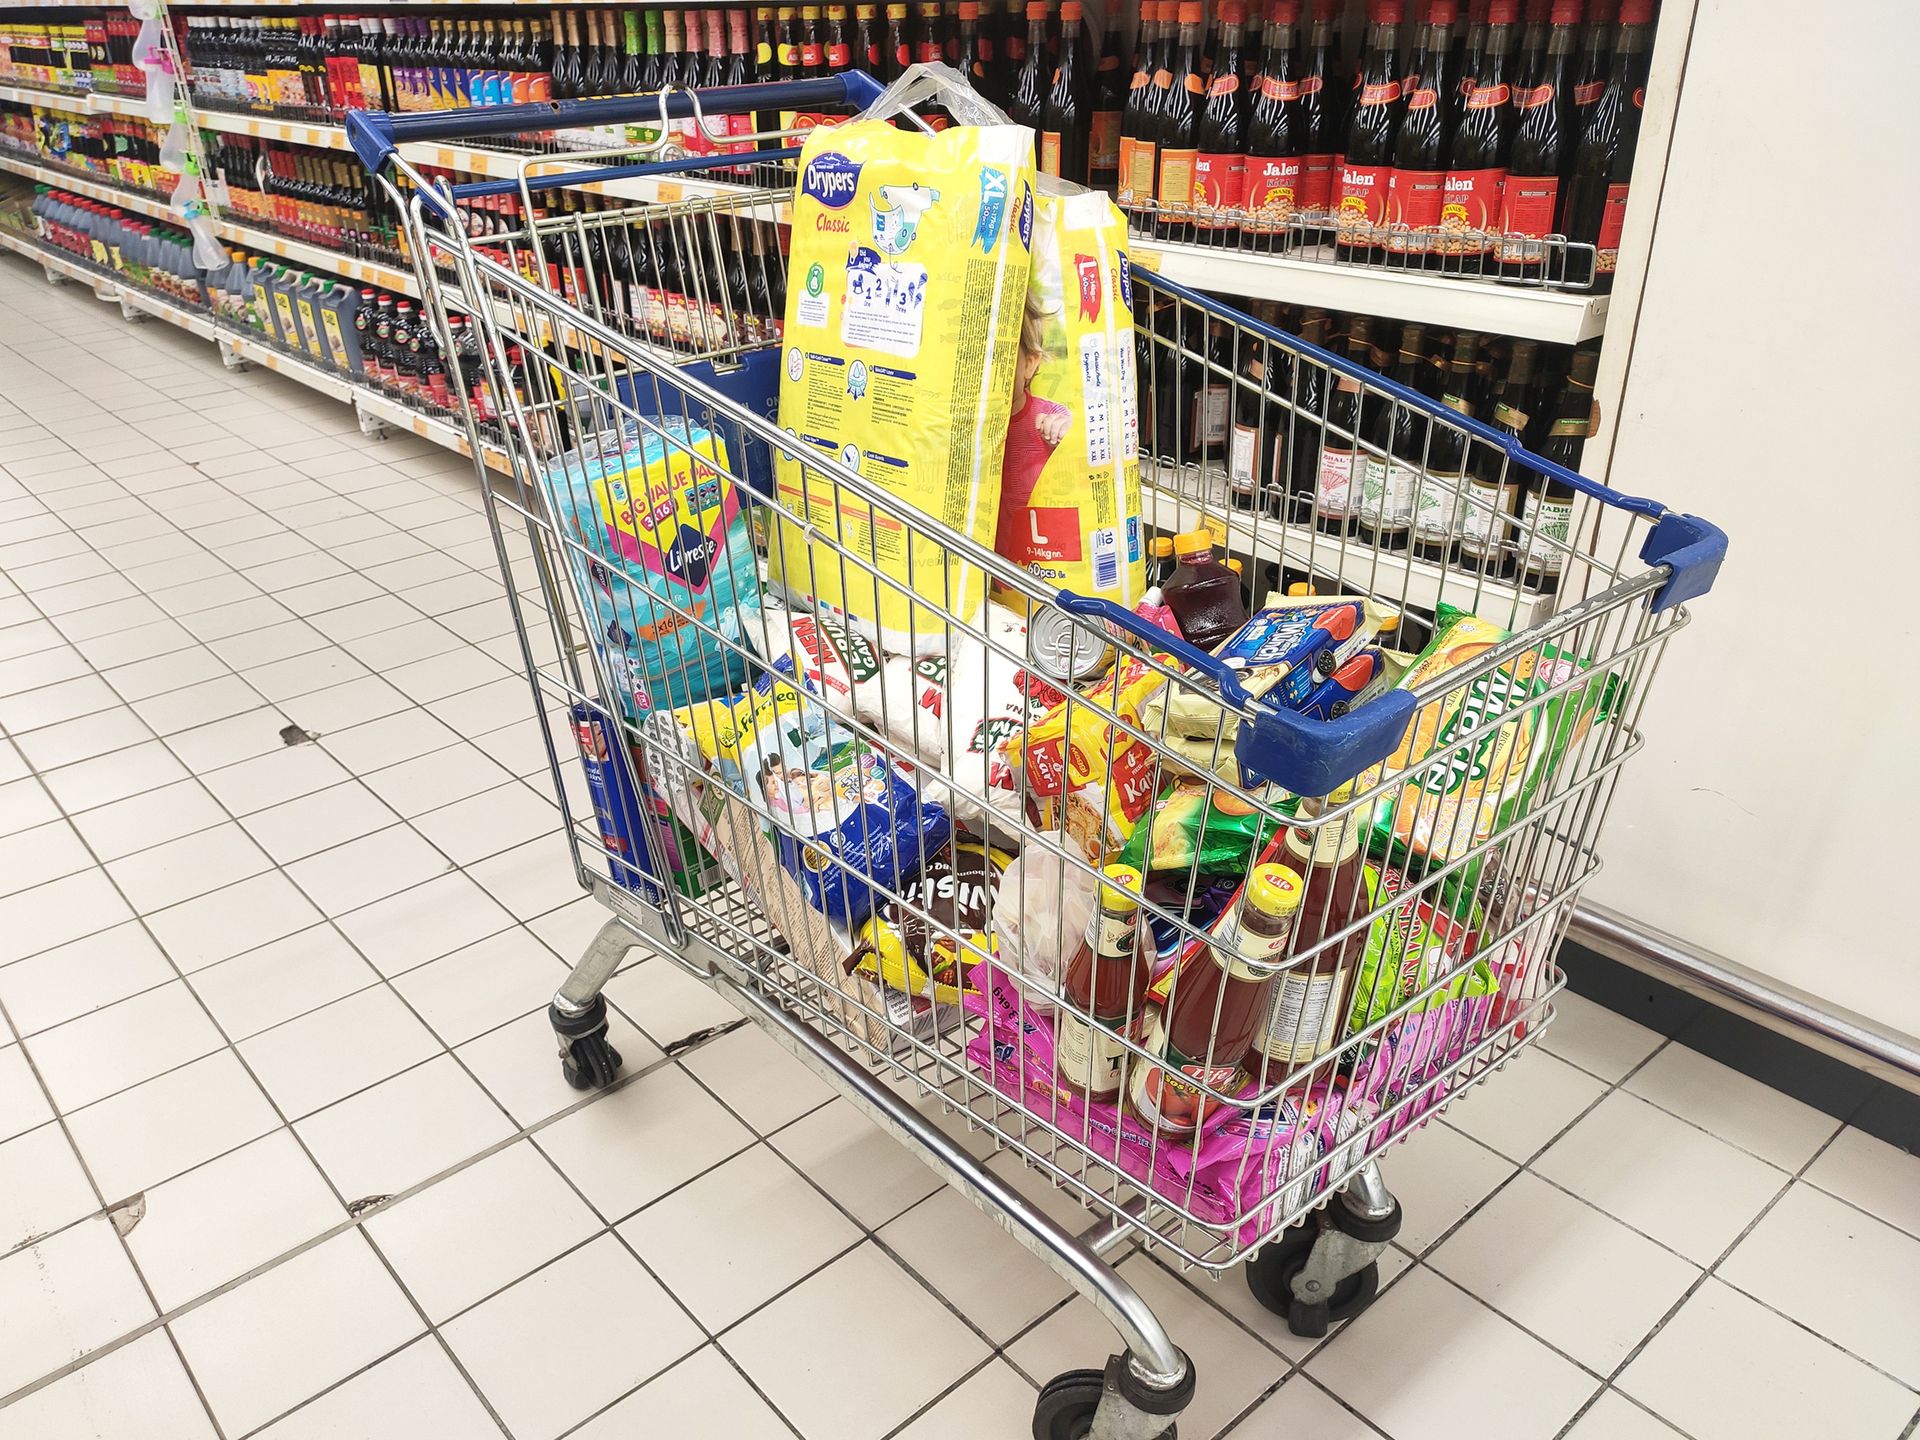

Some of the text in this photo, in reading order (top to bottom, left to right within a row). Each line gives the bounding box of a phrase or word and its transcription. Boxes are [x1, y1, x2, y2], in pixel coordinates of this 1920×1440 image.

[1195, 160, 1210, 171] len
[1263, 162, 1298, 176] Jalen
[807, 164, 855, 198] Drypers
[982, 171, 1006, 205] XL
[816, 213, 850, 233] Classic
[1008, 197, 1022, 234] Classic
[1022, 190, 1032, 244] Drypers
[1079, 261, 1097, 276] L
[876, 278, 882, 291] 2
[1110, 267, 1118, 303] Classic
[1120, 257, 1132, 308] Drypers
[865, 287, 872, 300] 1
[899, 293, 906, 305] 3
[620, 497, 646, 525] BG
[1029, 509, 1049, 544] L
[1104, 531, 1114, 544] 10
[1026, 546, 1052, 560] 9-14kg
[1026, 561, 1056, 578] 60pcs
[1033, 746, 1058, 790] Kari
[1071, 746, 1089, 774] Maggi
[1268, 875, 1291, 891] Life
[992, 985, 1020, 1020] 3.6kg
[1164, 1073, 1185, 1091] Sos
